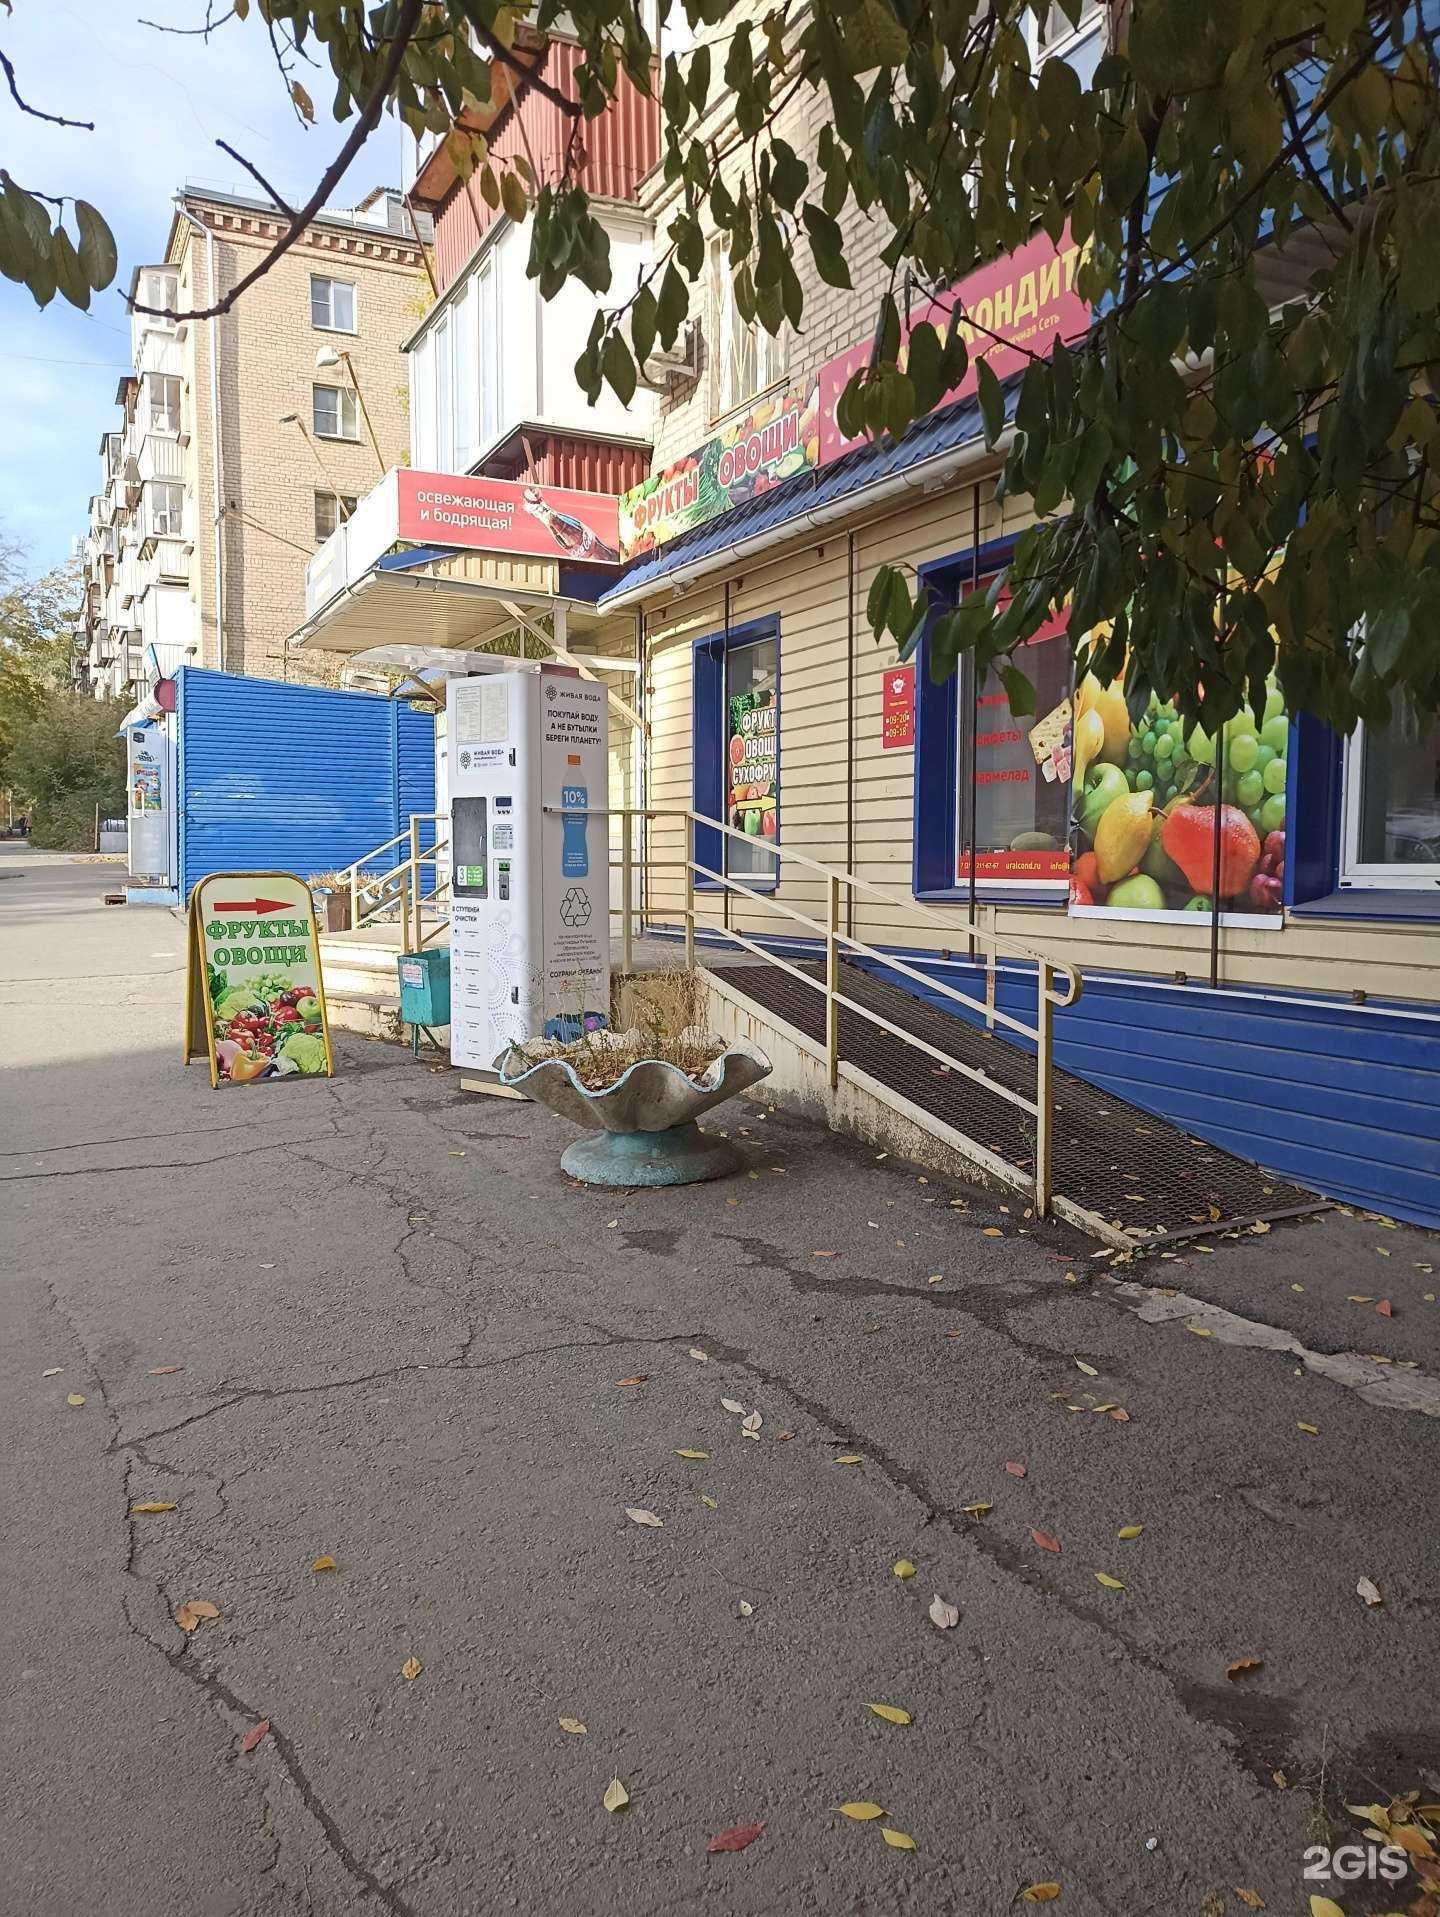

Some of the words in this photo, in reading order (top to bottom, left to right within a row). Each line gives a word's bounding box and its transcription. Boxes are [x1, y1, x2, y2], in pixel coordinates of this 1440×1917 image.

[633, 468, 700, 530] ФРУКТЫ
[719, 410, 799, 487] ОВОЩИ
[417, 490, 515, 513] освежающая
[420, 509, 430, 520] и
[433, 507, 512, 530] бодрящая!
[560, 691, 583, 700] ЖИВАЯ
[584, 694, 601, 702] ВОДА
[547, 709, 580, 720] ПОКУПАЙ
[742, 708, 776, 732] ФРУКТ
[545, 733, 569, 743] БЕРЕГИ
[551, 722, 556, 730] А
[557, 723, 566, 731] НЕ
[567, 723, 598, 733] БУТЫЛКИ
[733, 763, 777, 785] СУХОФРУ
[563, 790, 586, 804] 10%
[206, 919, 310, 940] ФРУКТЫ
[213, 945, 308, 967] ОВОЩИ
